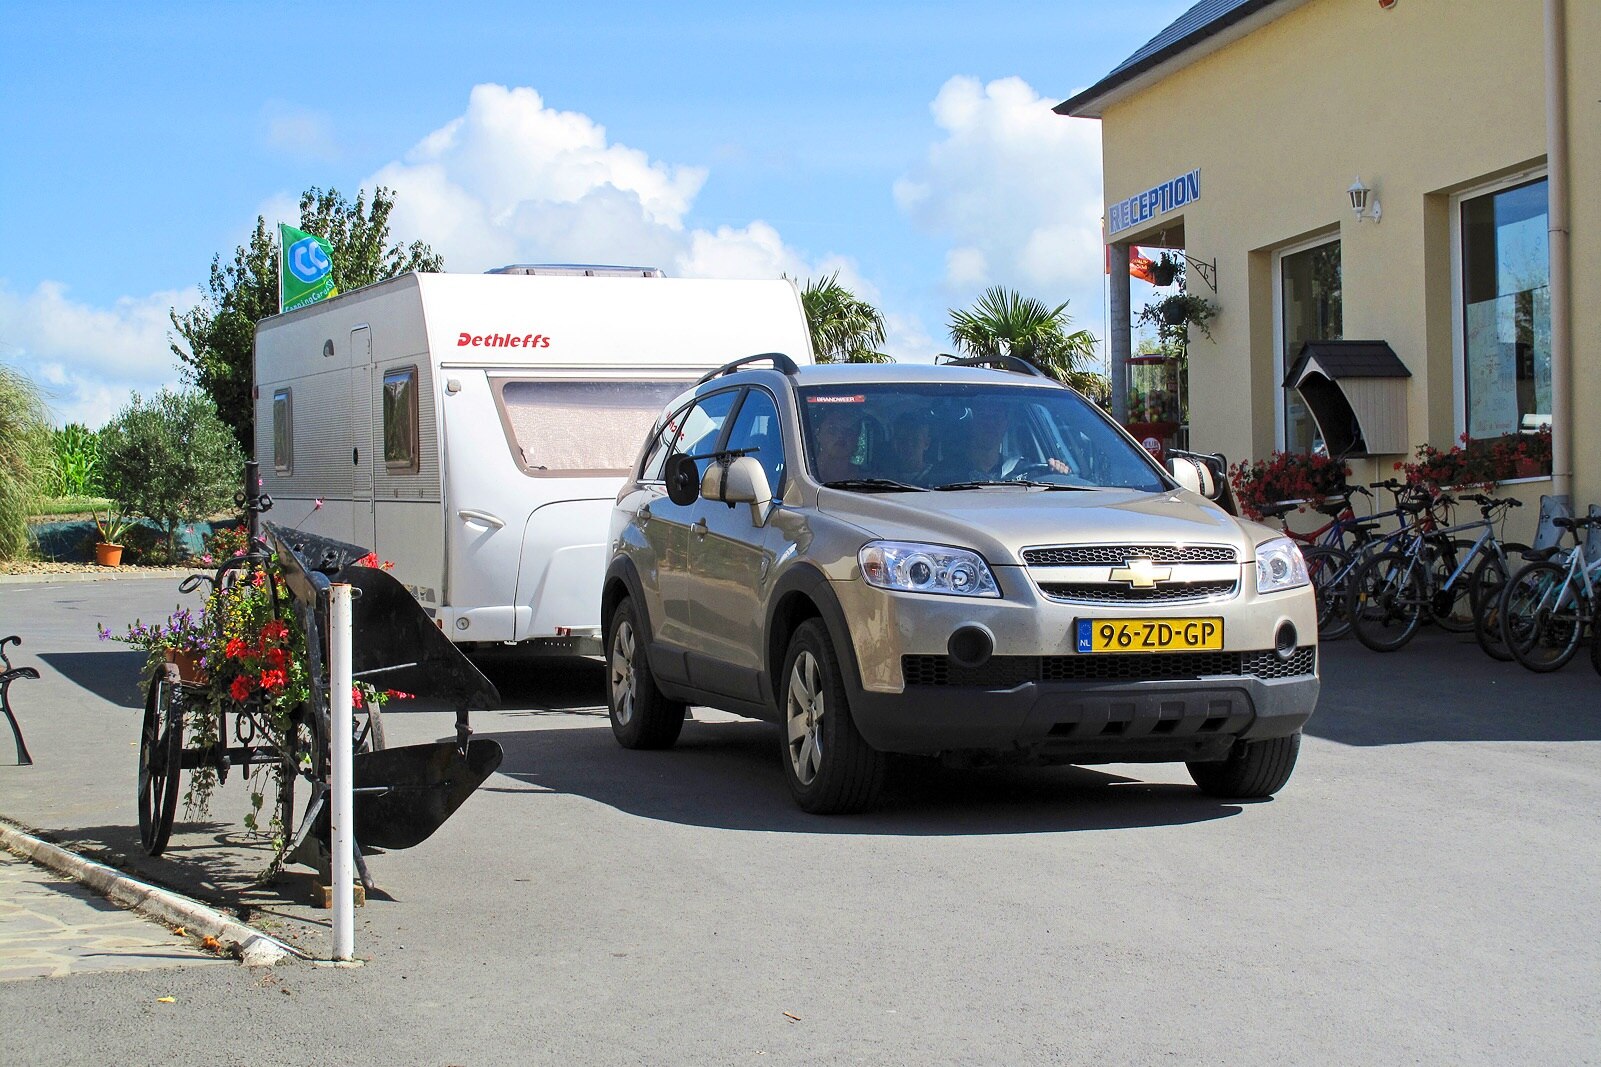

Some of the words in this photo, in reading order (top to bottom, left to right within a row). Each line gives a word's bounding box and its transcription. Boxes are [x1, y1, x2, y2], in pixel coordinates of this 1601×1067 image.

[1109, 168, 1200, 234] RECEPTION
[457, 332, 550, 348] Dethleffs
[1079, 639, 1090, 647] NL
[1099, 622, 1215, 648] 96-ZD-GP
